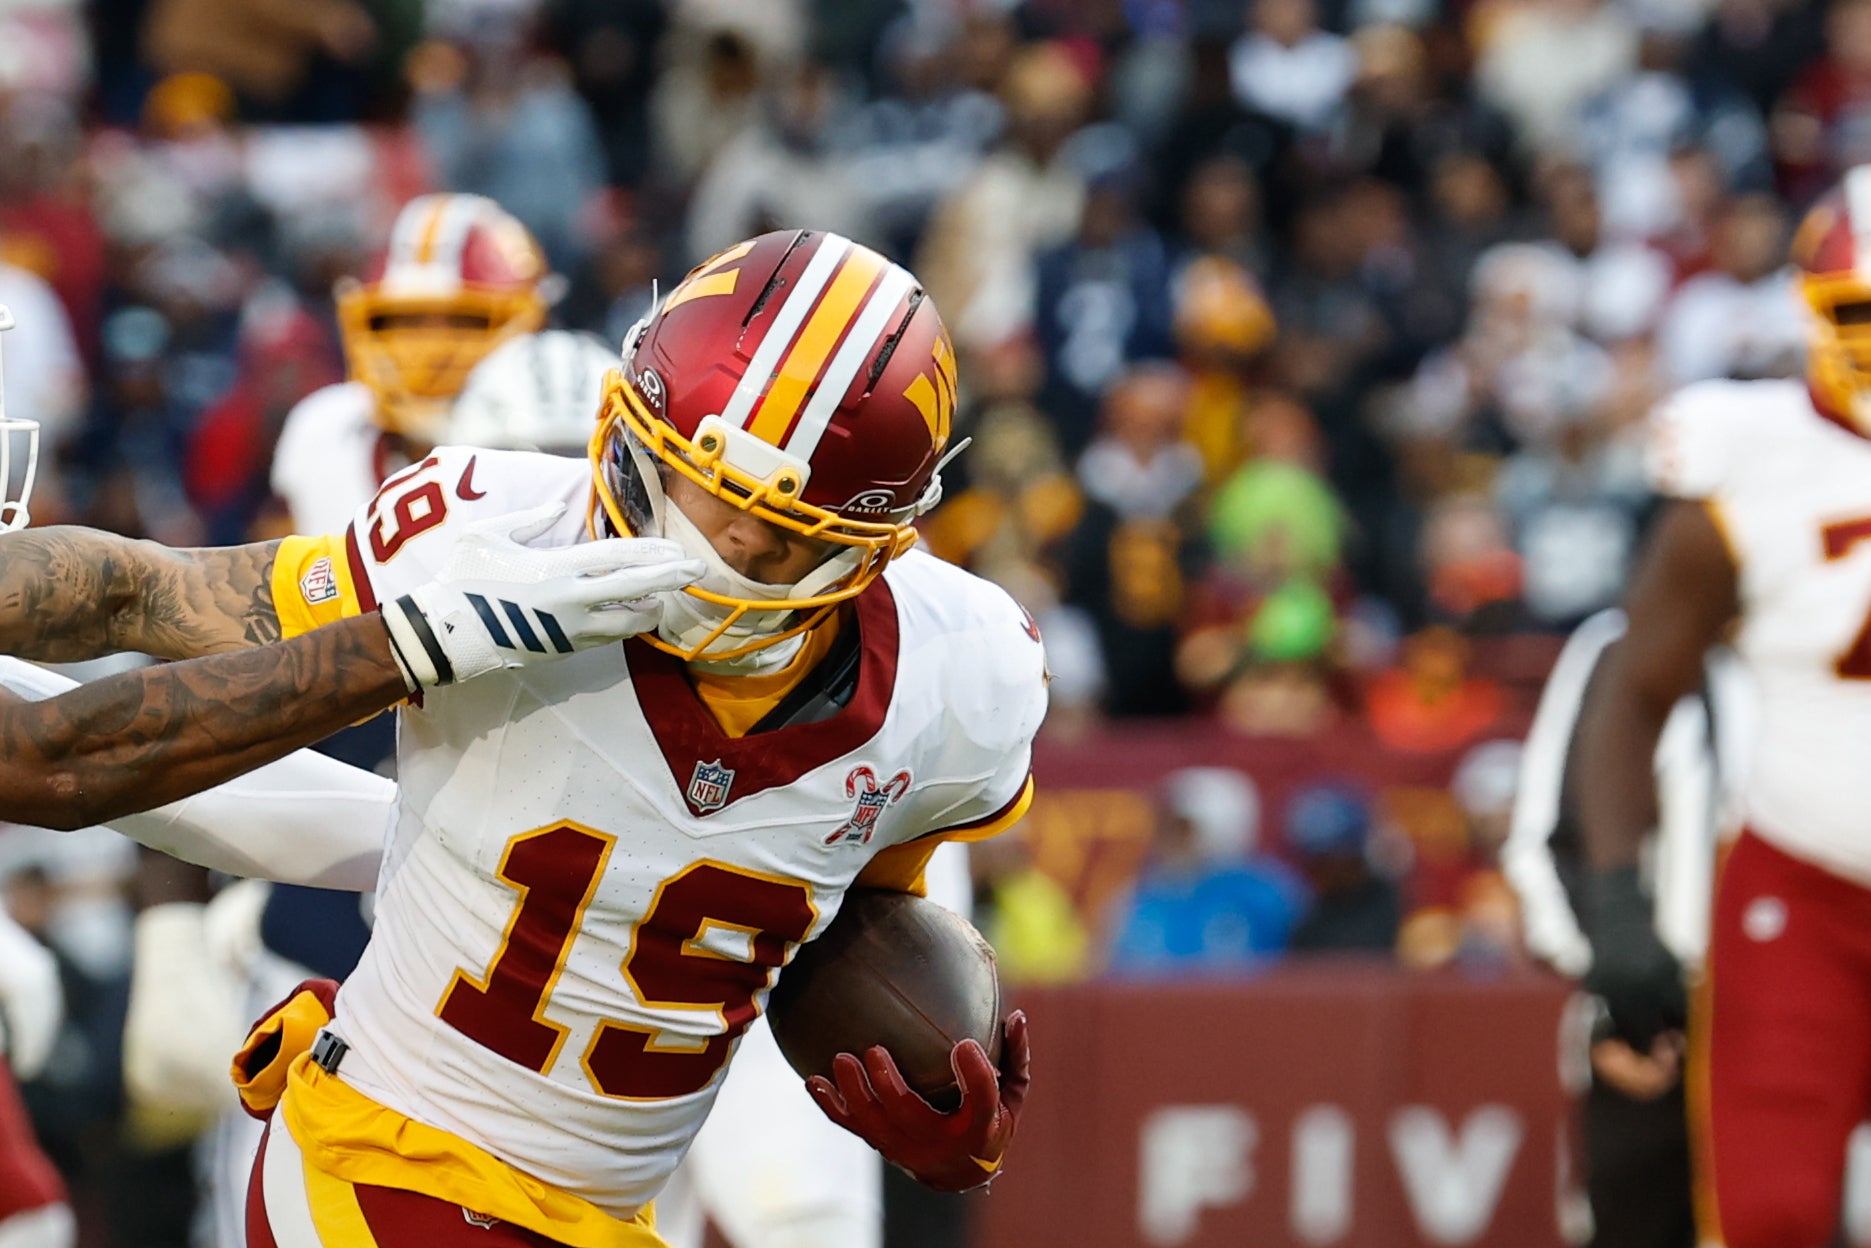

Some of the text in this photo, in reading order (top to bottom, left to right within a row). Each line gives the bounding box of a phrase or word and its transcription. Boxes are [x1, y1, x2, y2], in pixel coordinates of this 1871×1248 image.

[637, 374, 662, 408] OAKLEY
[369, 456, 449, 565] 19
[847, 505, 890, 513] OAKLEY
[309, 561, 328, 598] NFL
[693, 780, 723, 803] NFL
[435, 818, 820, 1101] 19
